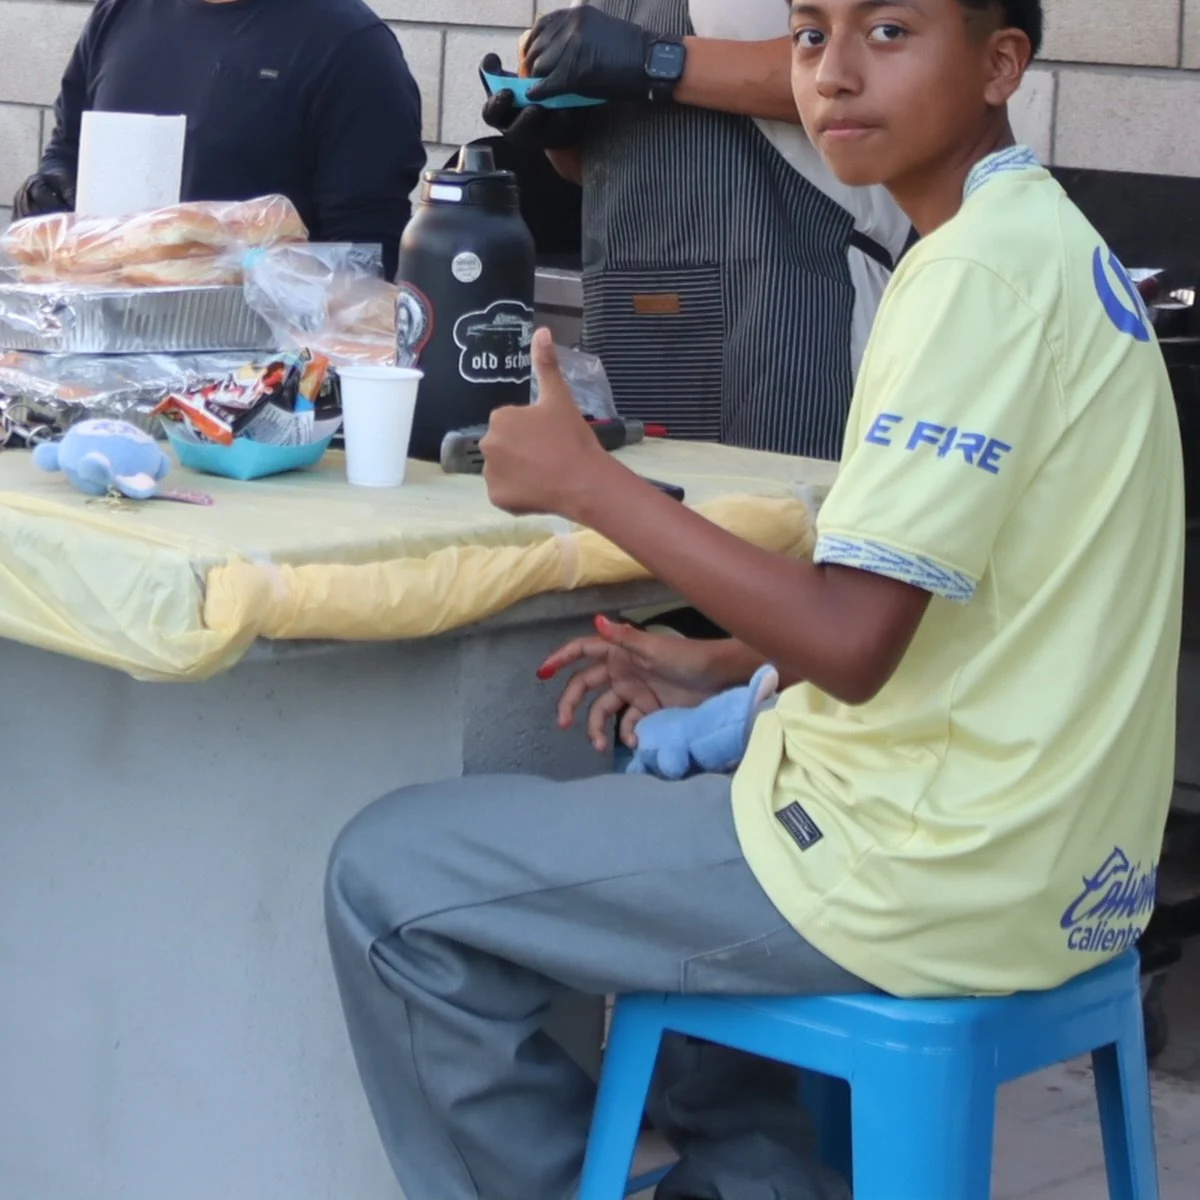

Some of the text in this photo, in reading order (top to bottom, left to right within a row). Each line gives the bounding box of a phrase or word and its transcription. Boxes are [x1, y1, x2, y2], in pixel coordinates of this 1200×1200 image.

[471, 350, 531, 370] old scho
[905, 420, 1013, 475] FIRE
